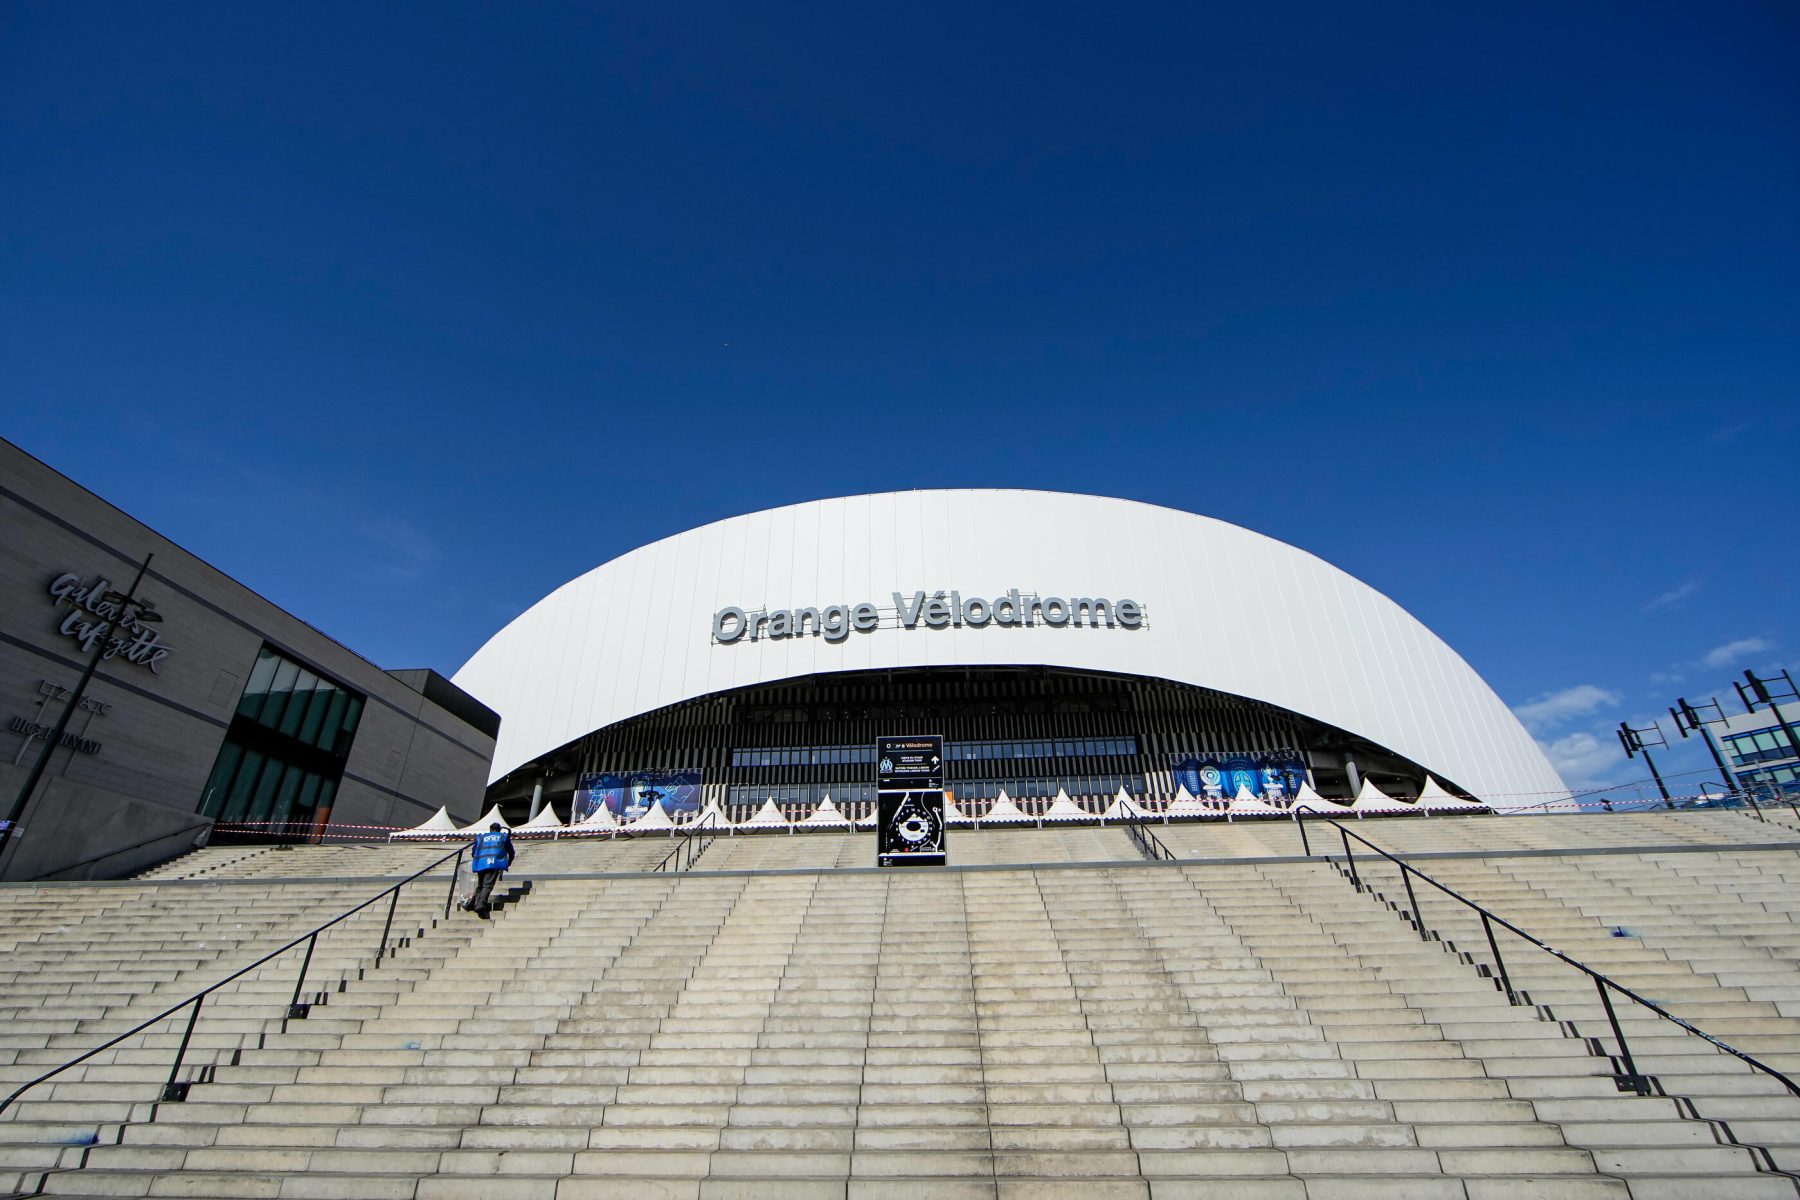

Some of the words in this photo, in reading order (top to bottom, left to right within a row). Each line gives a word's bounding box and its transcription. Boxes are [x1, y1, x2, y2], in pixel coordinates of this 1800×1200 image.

[50, 573, 140, 634] Galeres
[713, 602, 879, 643] Orange
[891, 589, 1143, 630] Vélodrome
